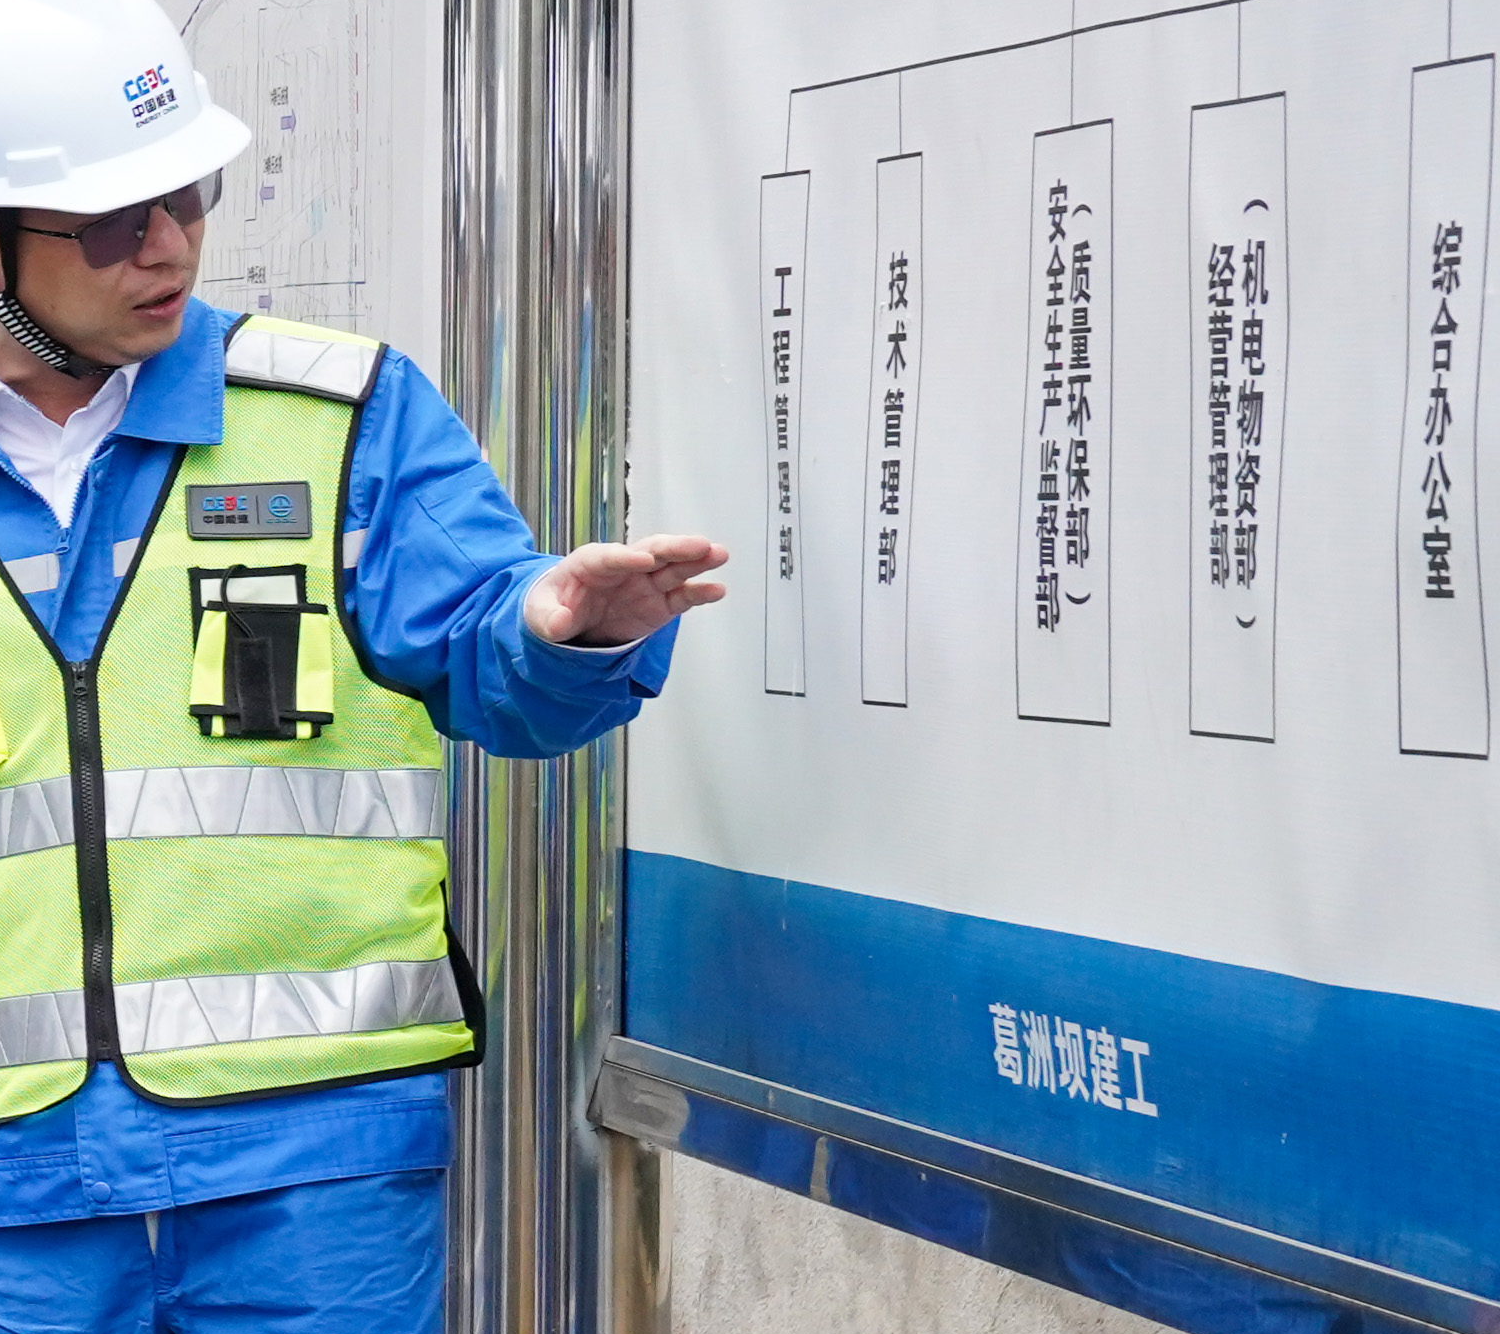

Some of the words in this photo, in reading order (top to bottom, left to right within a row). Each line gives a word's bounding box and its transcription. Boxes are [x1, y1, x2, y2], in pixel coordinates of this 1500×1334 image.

[132, 88, 176, 117] 中国能建
[773, 267, 793, 581] 工程管理部
[878, 250, 909, 586] 技术管理部
[1035, 178, 1068, 633] 安全生产监督部
[1208, 243, 1236, 589] 经营管理部
[1422, 220, 1464, 599] 综合办公室
[989, 1002, 1159, 1118] 葛洲坝建工
